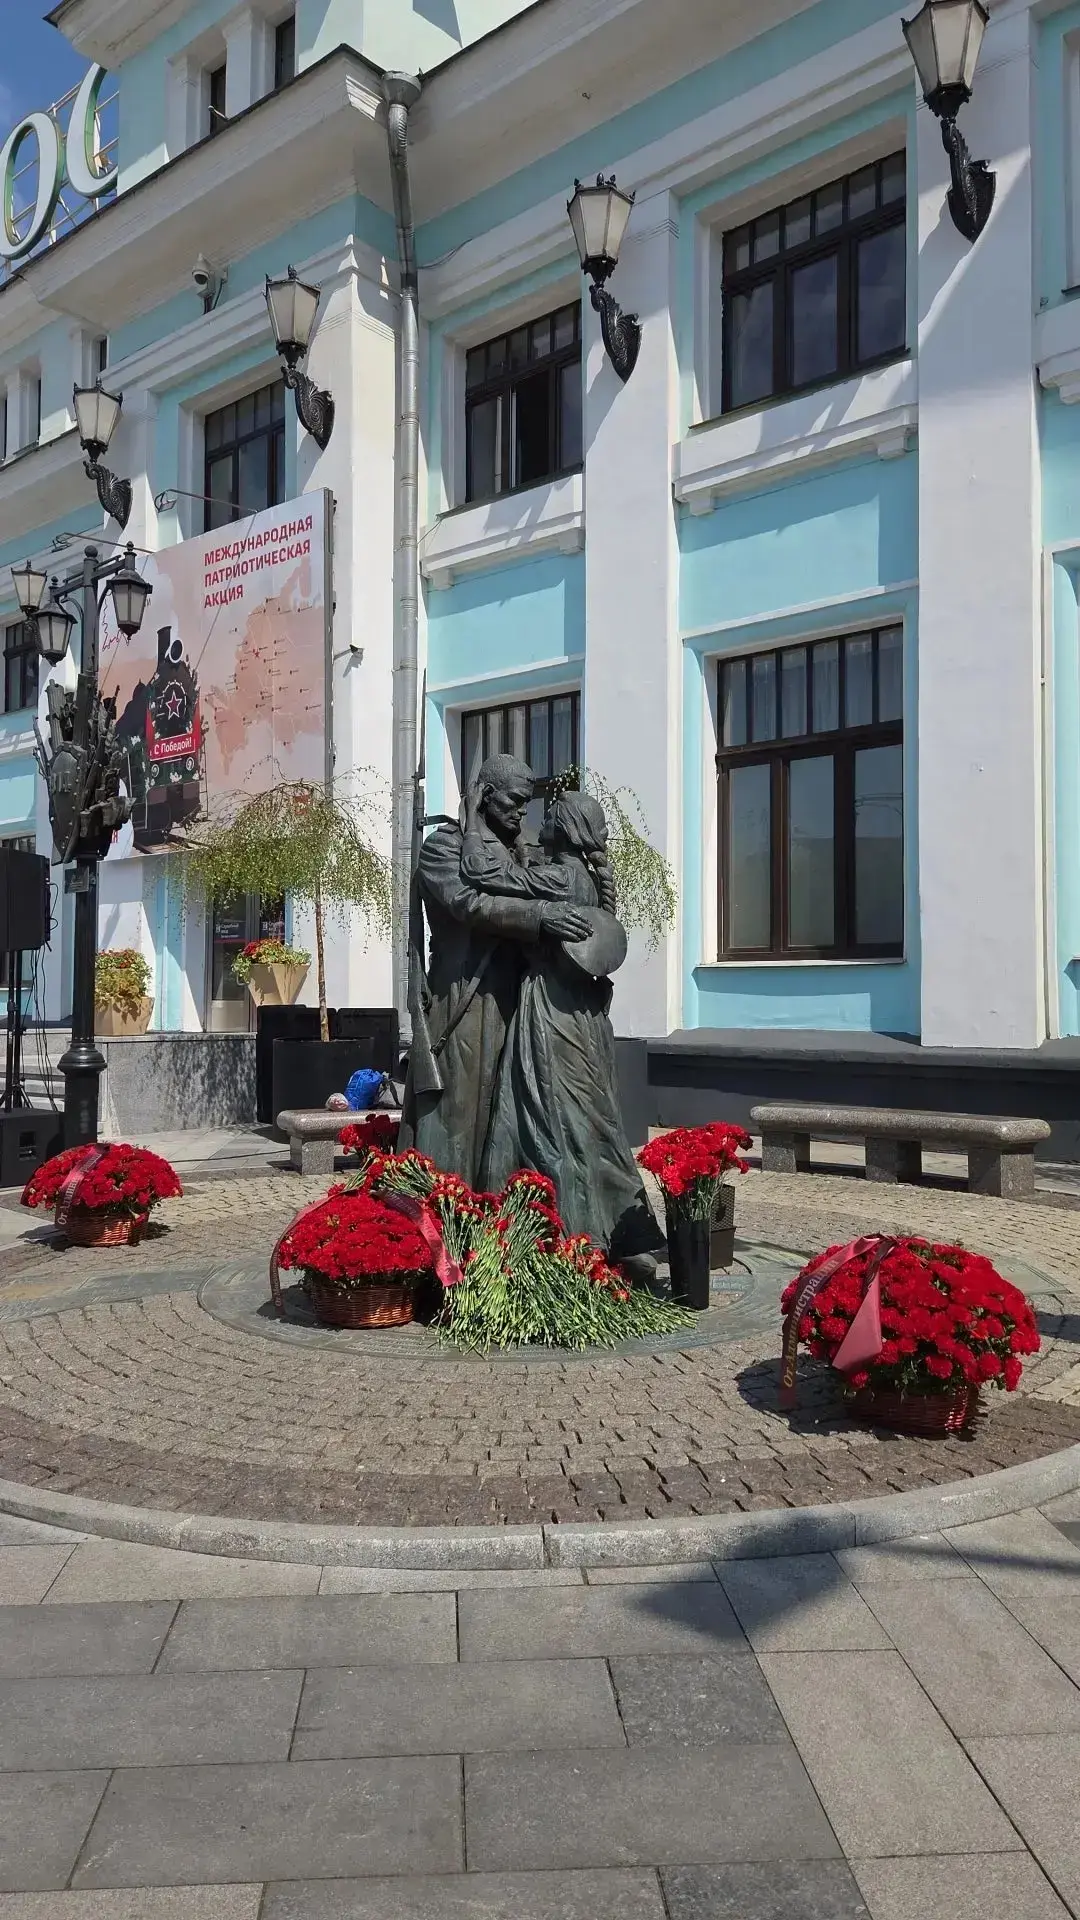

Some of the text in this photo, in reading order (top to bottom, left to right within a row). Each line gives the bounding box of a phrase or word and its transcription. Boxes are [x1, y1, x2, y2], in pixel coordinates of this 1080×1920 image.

[204, 515, 313, 567] МЕЖДУНАРОДНАЯ
[204, 539, 311, 588] ПАТРИОТИЧЕСКАЯ
[204, 584, 244, 609] АКЦИЯ
[154, 736, 192, 755] С Победой!
[57, 1212, 68, 1225] От
[783, 1367, 794, 1388] От
